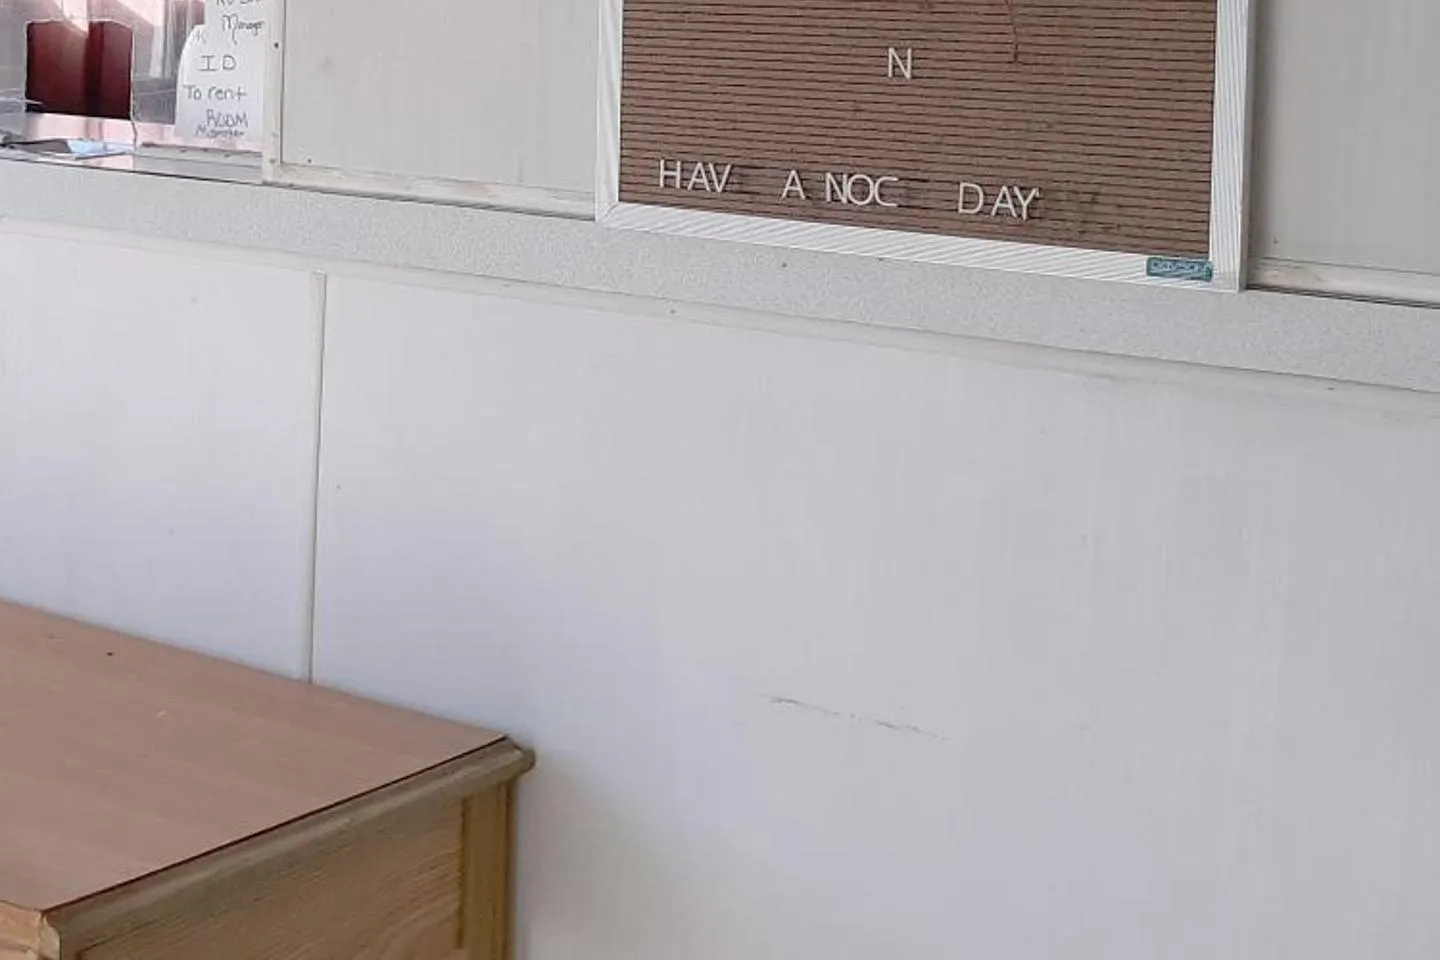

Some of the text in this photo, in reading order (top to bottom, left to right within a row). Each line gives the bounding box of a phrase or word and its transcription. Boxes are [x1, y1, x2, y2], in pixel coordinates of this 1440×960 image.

[887, 46, 913, 80] N
[182, 84, 248, 101] To rent
[780, 169, 807, 201] A
[957, 182, 1040, 222] DAY
